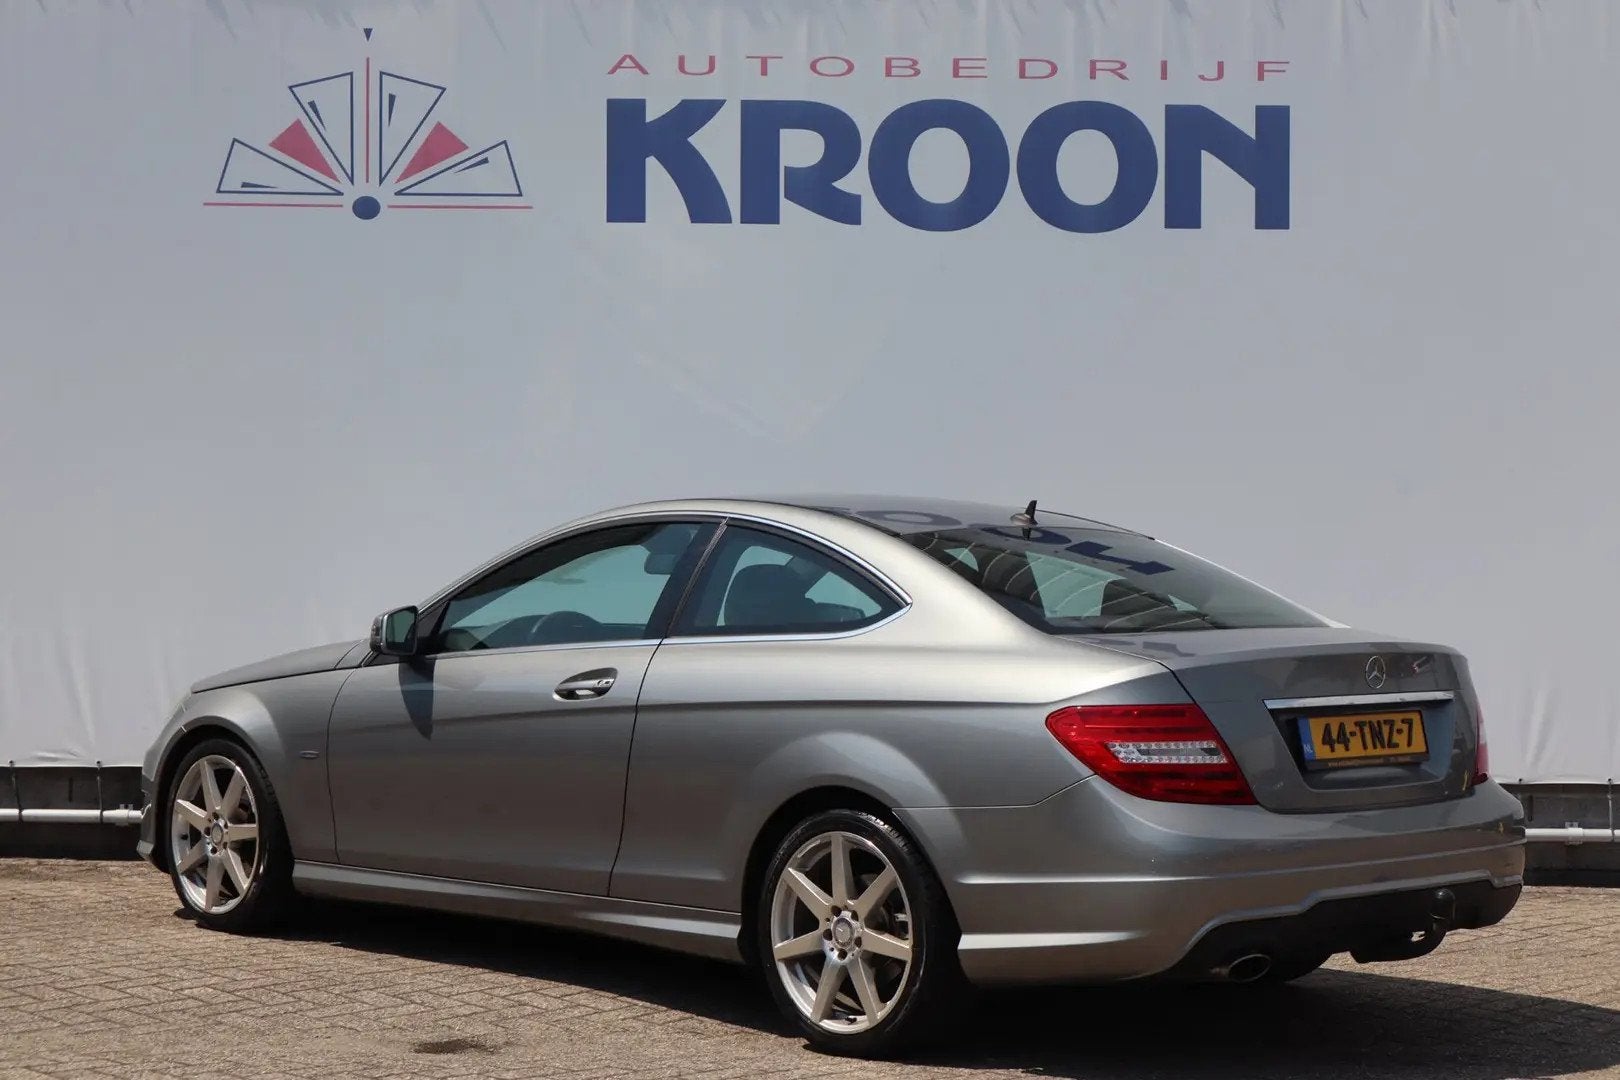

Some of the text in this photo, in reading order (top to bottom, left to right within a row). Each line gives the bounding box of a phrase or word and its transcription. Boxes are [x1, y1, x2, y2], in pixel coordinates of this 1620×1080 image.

[606, 53, 1291, 82] AUTOBEDRIJF
[606, 98, 1290, 233] KROON
[1321, 718, 1414, 753] 44-TNZ-7
